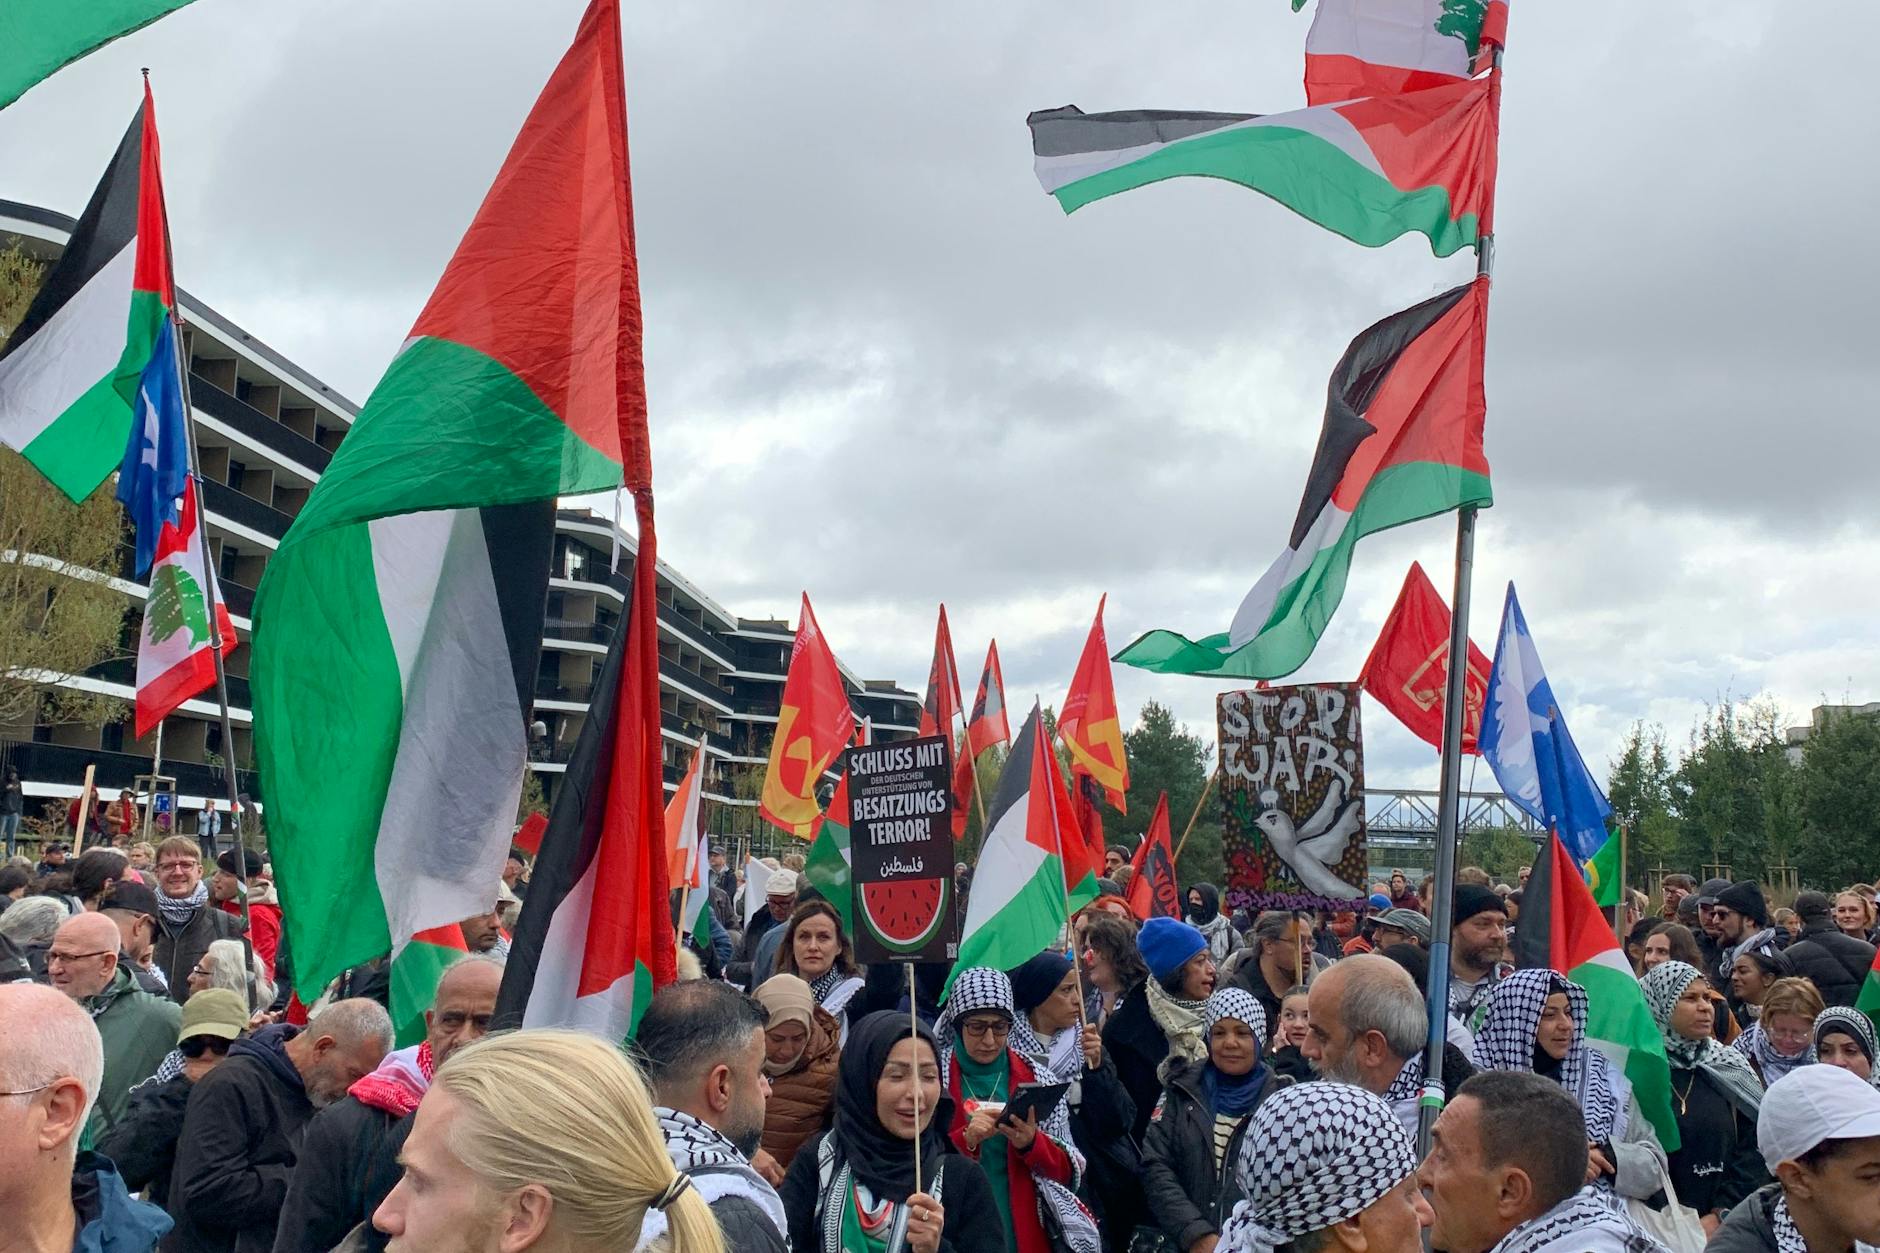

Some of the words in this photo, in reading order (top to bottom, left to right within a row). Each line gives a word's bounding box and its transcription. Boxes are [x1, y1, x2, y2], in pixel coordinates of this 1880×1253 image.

[850, 746, 914, 777] SCHLUSS
[916, 742, 944, 769] MIT
[861, 782, 917, 796] UNTERSTÜTZUNG
[917, 780, 933, 789] VON
[870, 775, 884, 785] DER
[884, 771, 924, 784] DEUTSCHEN
[853, 789, 946, 821] BESATZUNGS
[867, 817, 931, 846] TERROR!
[880, 855, 923, 878] فلسطين
